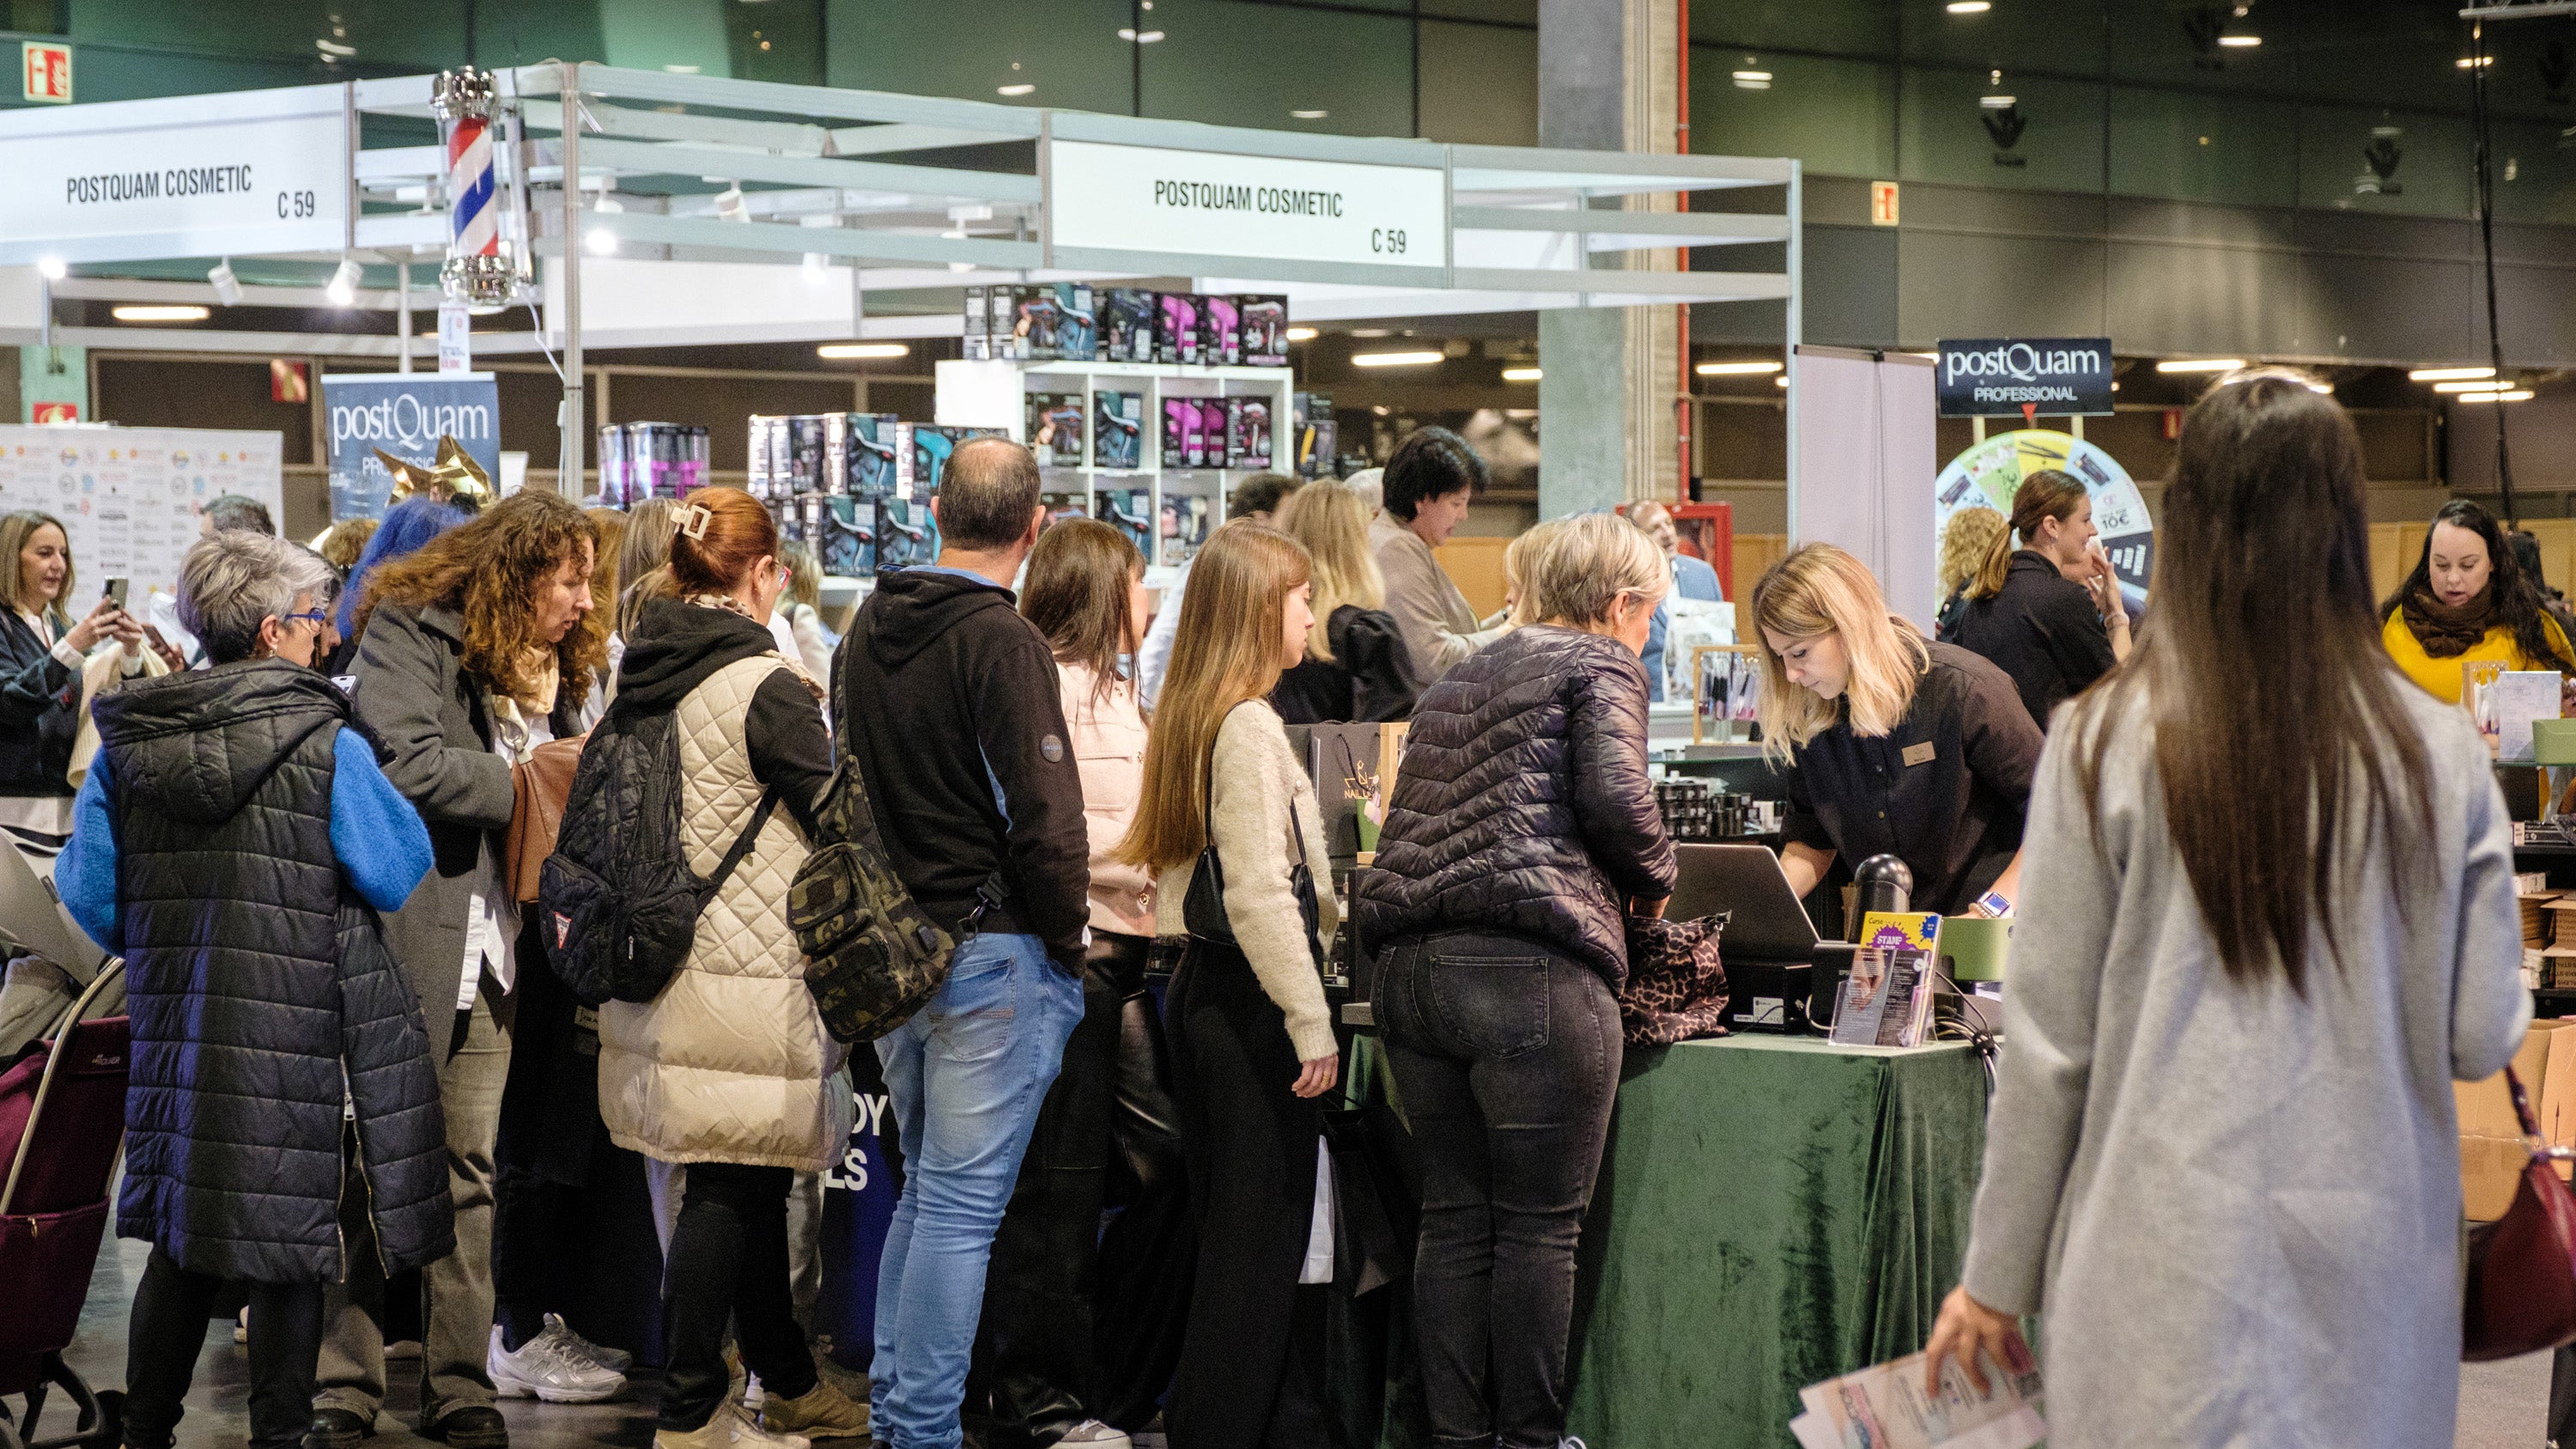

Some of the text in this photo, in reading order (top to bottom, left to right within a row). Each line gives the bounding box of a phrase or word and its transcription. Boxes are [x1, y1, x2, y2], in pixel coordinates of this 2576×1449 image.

[67, 164, 252, 204] POSTQUAM COSMETIC
[1155, 180, 1343, 217] POSTQUAM COSMETIC
[277, 191, 314, 218] C 59
[1371, 228, 1406, 253] C 59
[1947, 343, 2100, 387] postQuam
[1974, 387, 2078, 402] PROFESSIONAL
[332, 393, 489, 457] postQuam
[852, 1092, 889, 1135] DY
[825, 1148, 868, 1190] LS
